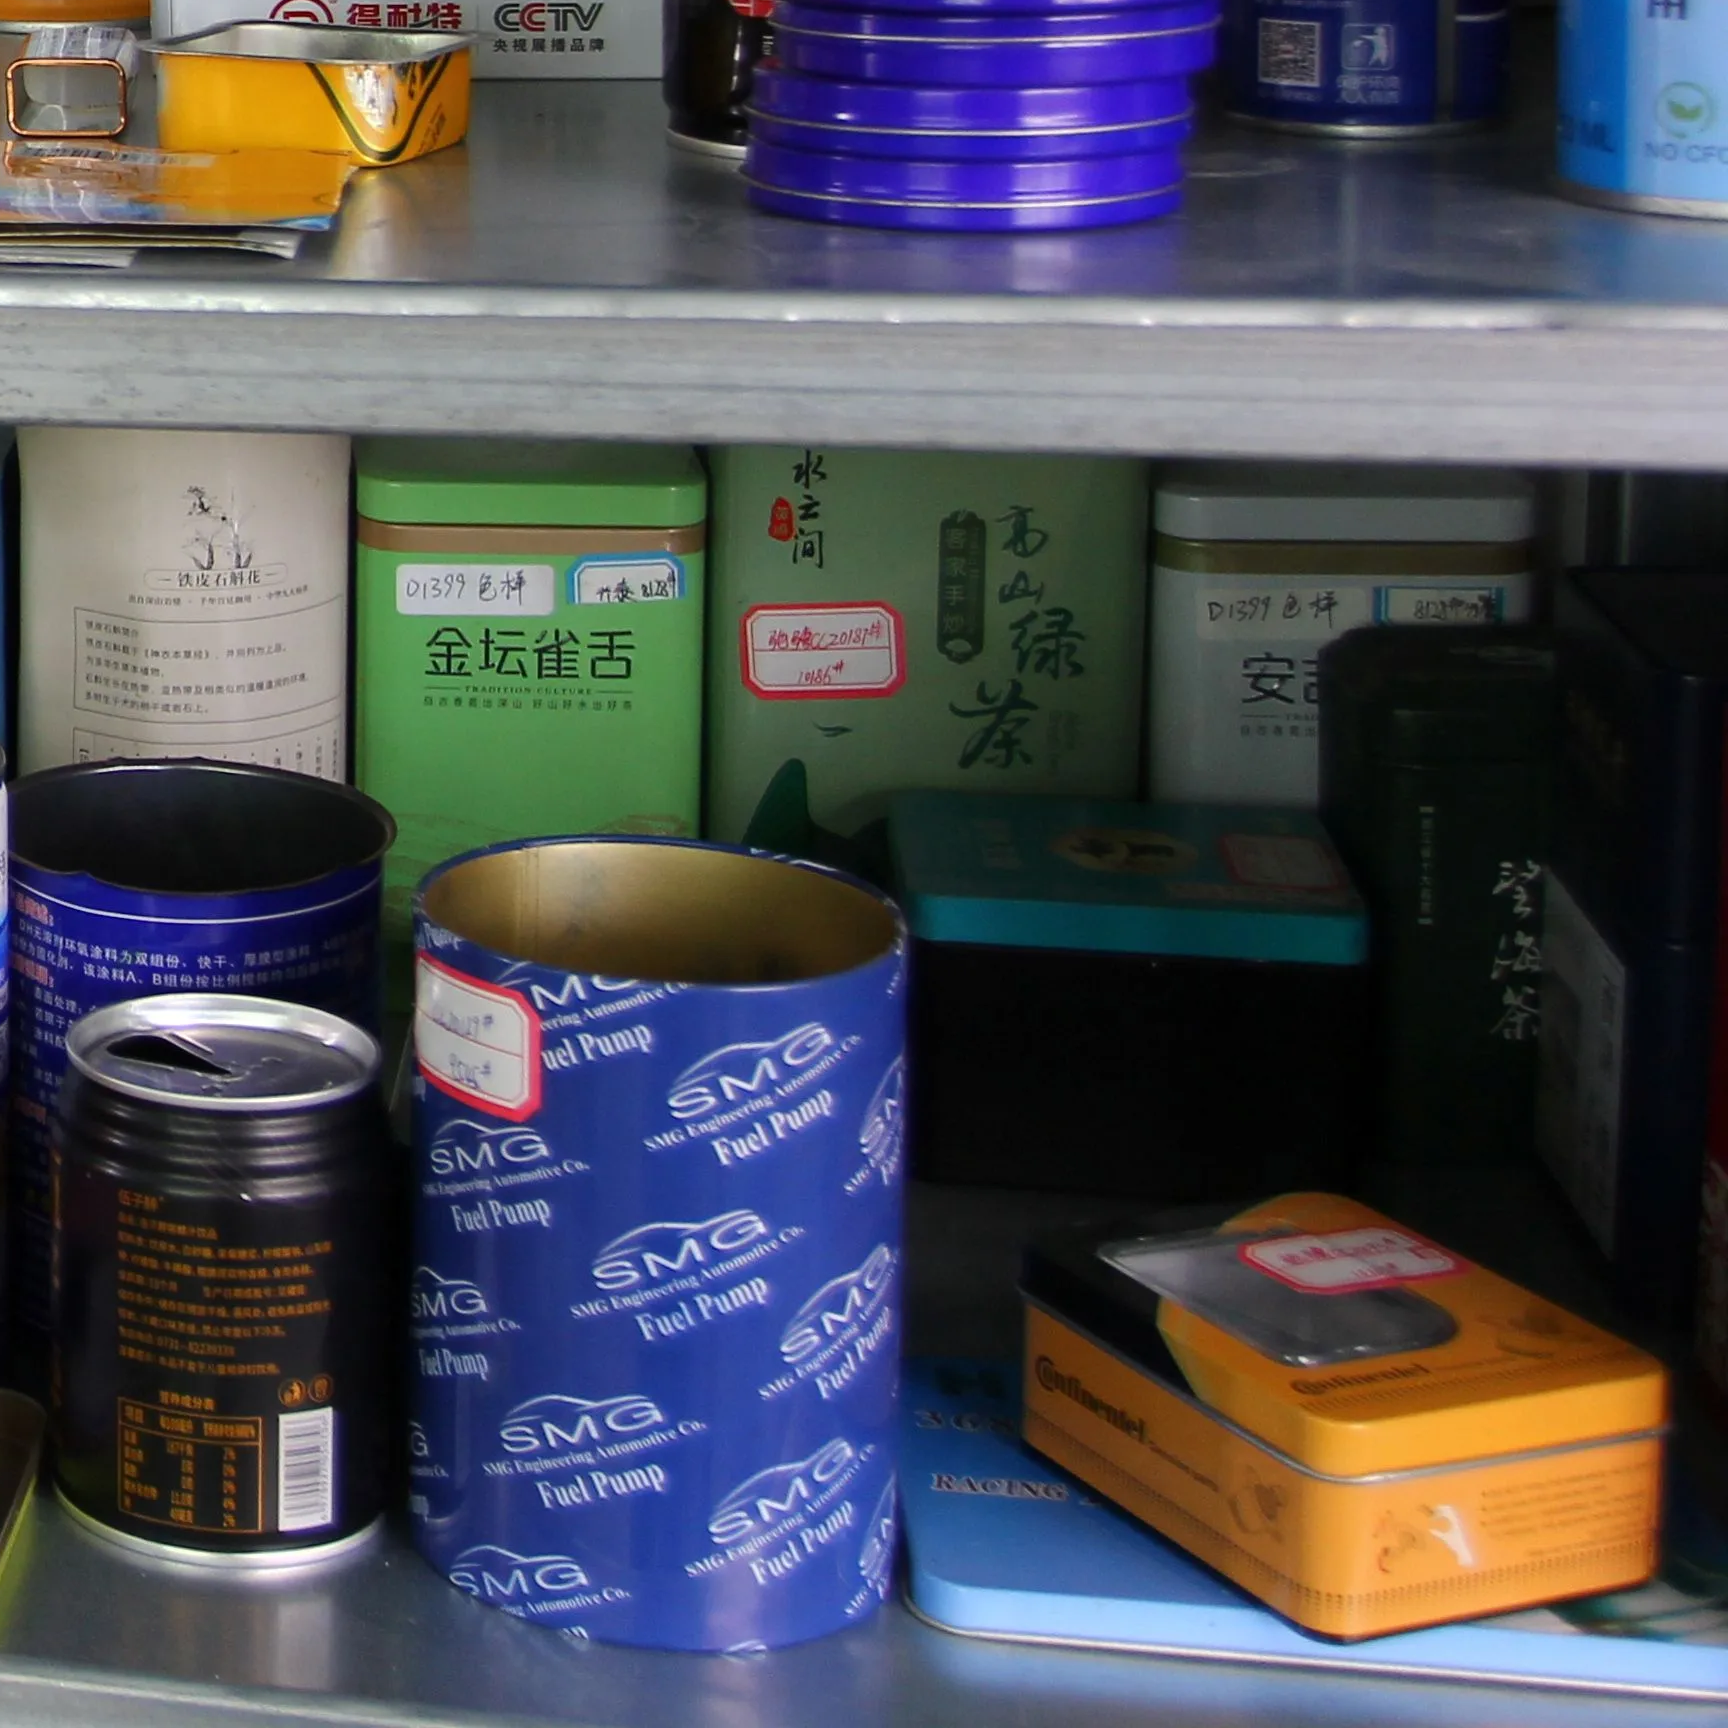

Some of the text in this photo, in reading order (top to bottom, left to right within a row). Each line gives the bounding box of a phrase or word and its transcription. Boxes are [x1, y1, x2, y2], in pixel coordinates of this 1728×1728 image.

[492, 36, 606, 54] 央视展播品牌
[493, 1, 605, 33] CCTV
[791, 449, 828, 570] 水云间
[424, 626, 638, 681] 金坛雀舌
[667, 1022, 834, 1120] SMG
[683, 1094, 774, 1137] Engineering
[770, 1046, 846, 1100] Automotive
[430, 1129, 550, 1175] SMG
[711, 1087, 835, 1168] Fuel Pump
[450, 1195, 552, 1235] Fuel Pump
[592, 1211, 769, 1292] SMG
[609, 1274, 699, 1311] Engineering
[697, 1239, 778, 1285] Automotive
[635, 1274, 770, 1344] Fuel Pump
[499, 1396, 665, 1455] SMG
[513, 1447, 596, 1474] Engineering
[594, 1428, 678, 1461] Automotive
[535, 1459, 667, 1511] Fuel Pump
[708, 1439, 854, 1546] SMG
[746, 1499, 855, 1587] Fuel Pump
